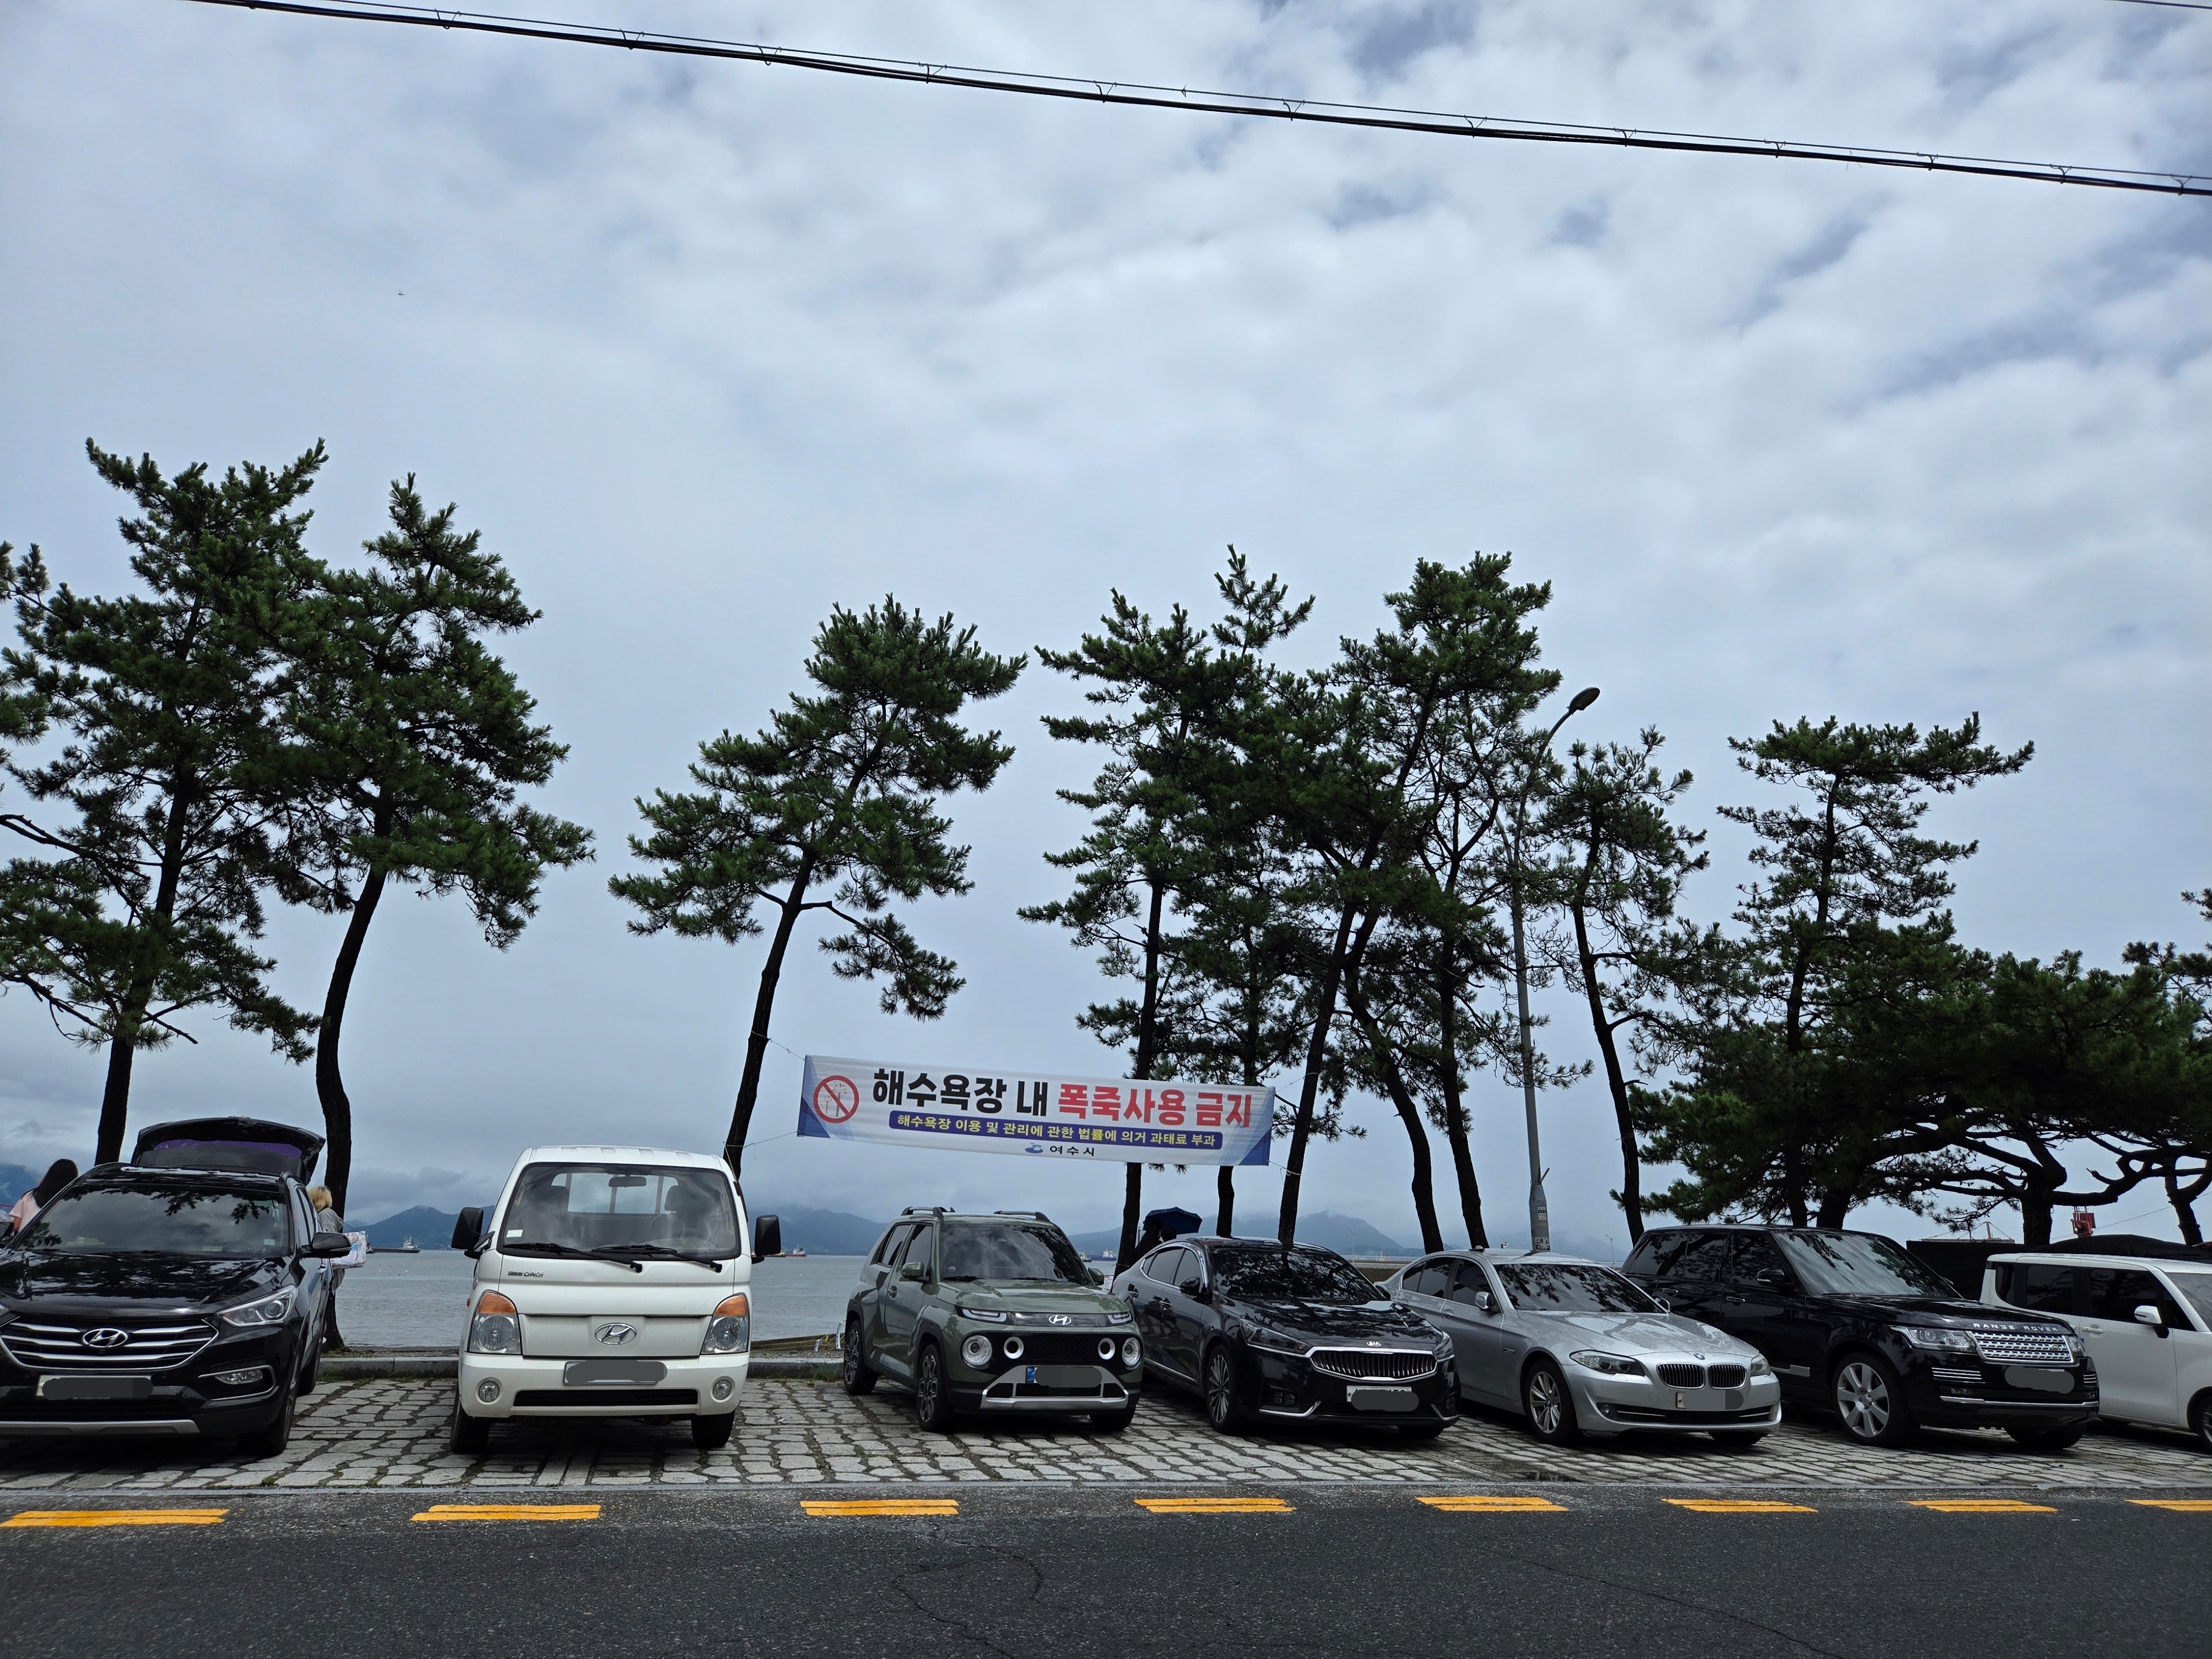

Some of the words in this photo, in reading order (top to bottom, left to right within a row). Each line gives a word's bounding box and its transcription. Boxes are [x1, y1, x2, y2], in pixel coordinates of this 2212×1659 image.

[873, 1068, 1007, 1114] 해수욕장
[1016, 1081, 1048, 1117] 내
[1058, 1083, 1186, 1126] 폭죽사용
[1196, 1092, 1252, 1128] 금지
[898, 1115, 951, 1130] 해수욕장
[956, 1119, 982, 1133] 이용
[987, 1121, 998, 1134] 및
[1003, 1123, 1043, 1137] 관리에
[1047, 1126, 1074, 1139] 관한
[1078, 1128, 1117, 1142] 법률에
[1121, 1131, 1147, 1144] 의거
[1150, 1133, 1188, 1146] 과태료
[1191, 1134, 1215, 1146] 부과
[1050, 1145, 1095, 1156] 여수시
